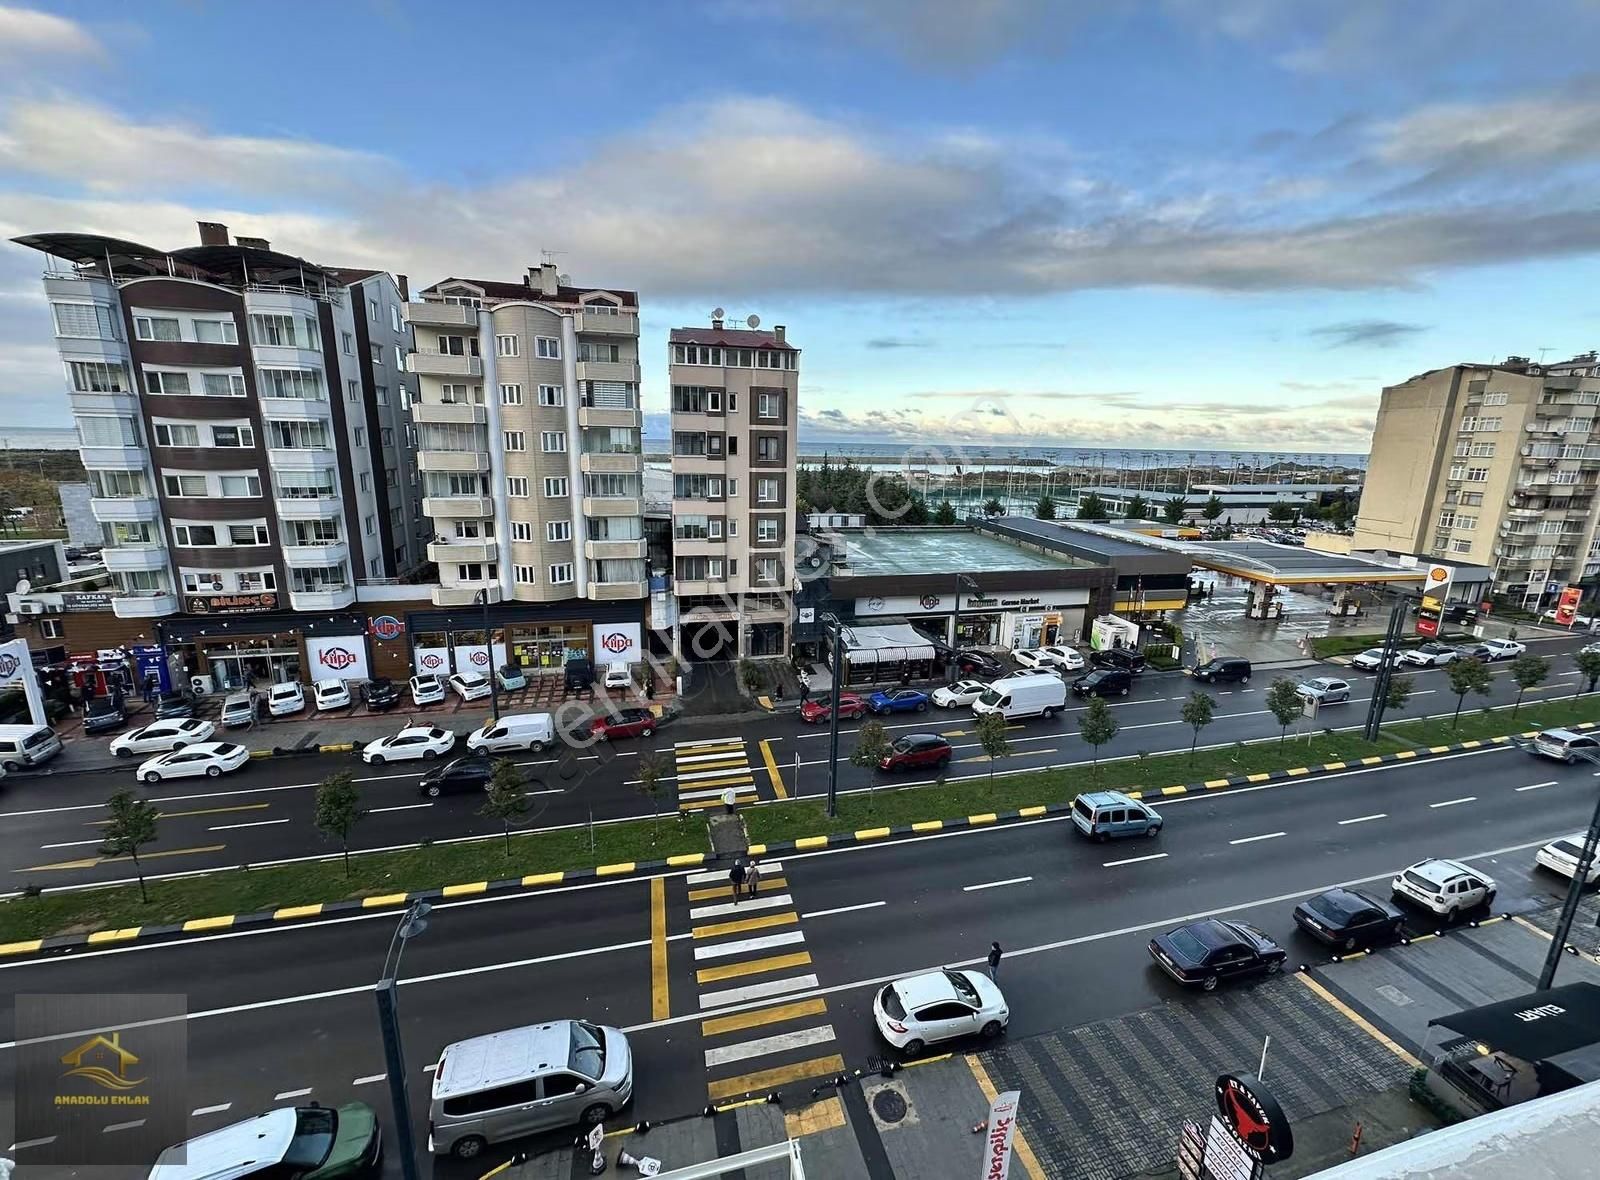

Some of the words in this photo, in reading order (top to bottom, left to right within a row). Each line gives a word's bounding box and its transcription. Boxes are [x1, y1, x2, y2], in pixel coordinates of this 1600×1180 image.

[602, 634, 633, 654] kilpa
[319, 646, 357, 670] kilpa
[420, 654, 444, 669] kilpa
[1246, 1090, 1271, 1125] TAVUK
